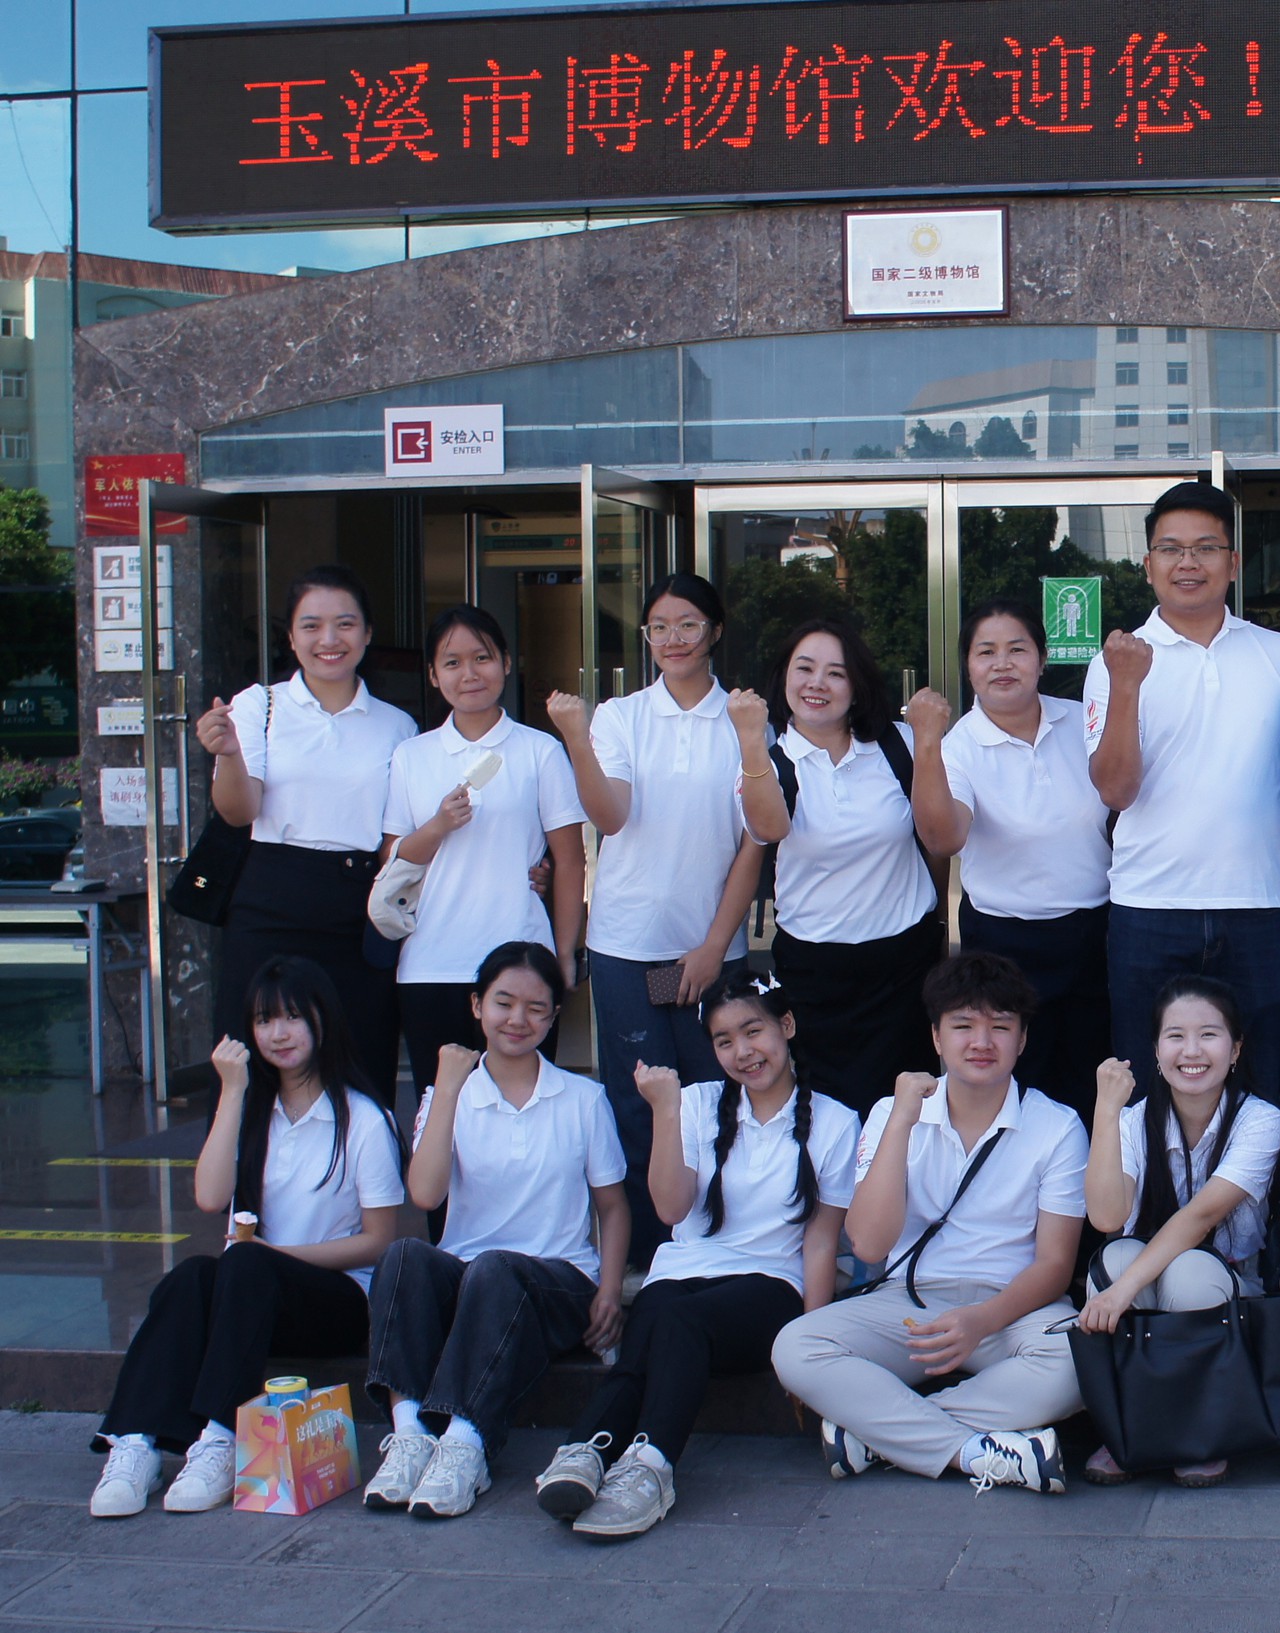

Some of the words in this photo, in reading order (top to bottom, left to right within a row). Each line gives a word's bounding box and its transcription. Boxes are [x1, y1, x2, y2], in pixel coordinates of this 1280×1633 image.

[871, 264, 980, 282] 国家二级博物馆
[440, 430, 494, 445] 安检入口
[453, 446, 482, 454] ENTER
